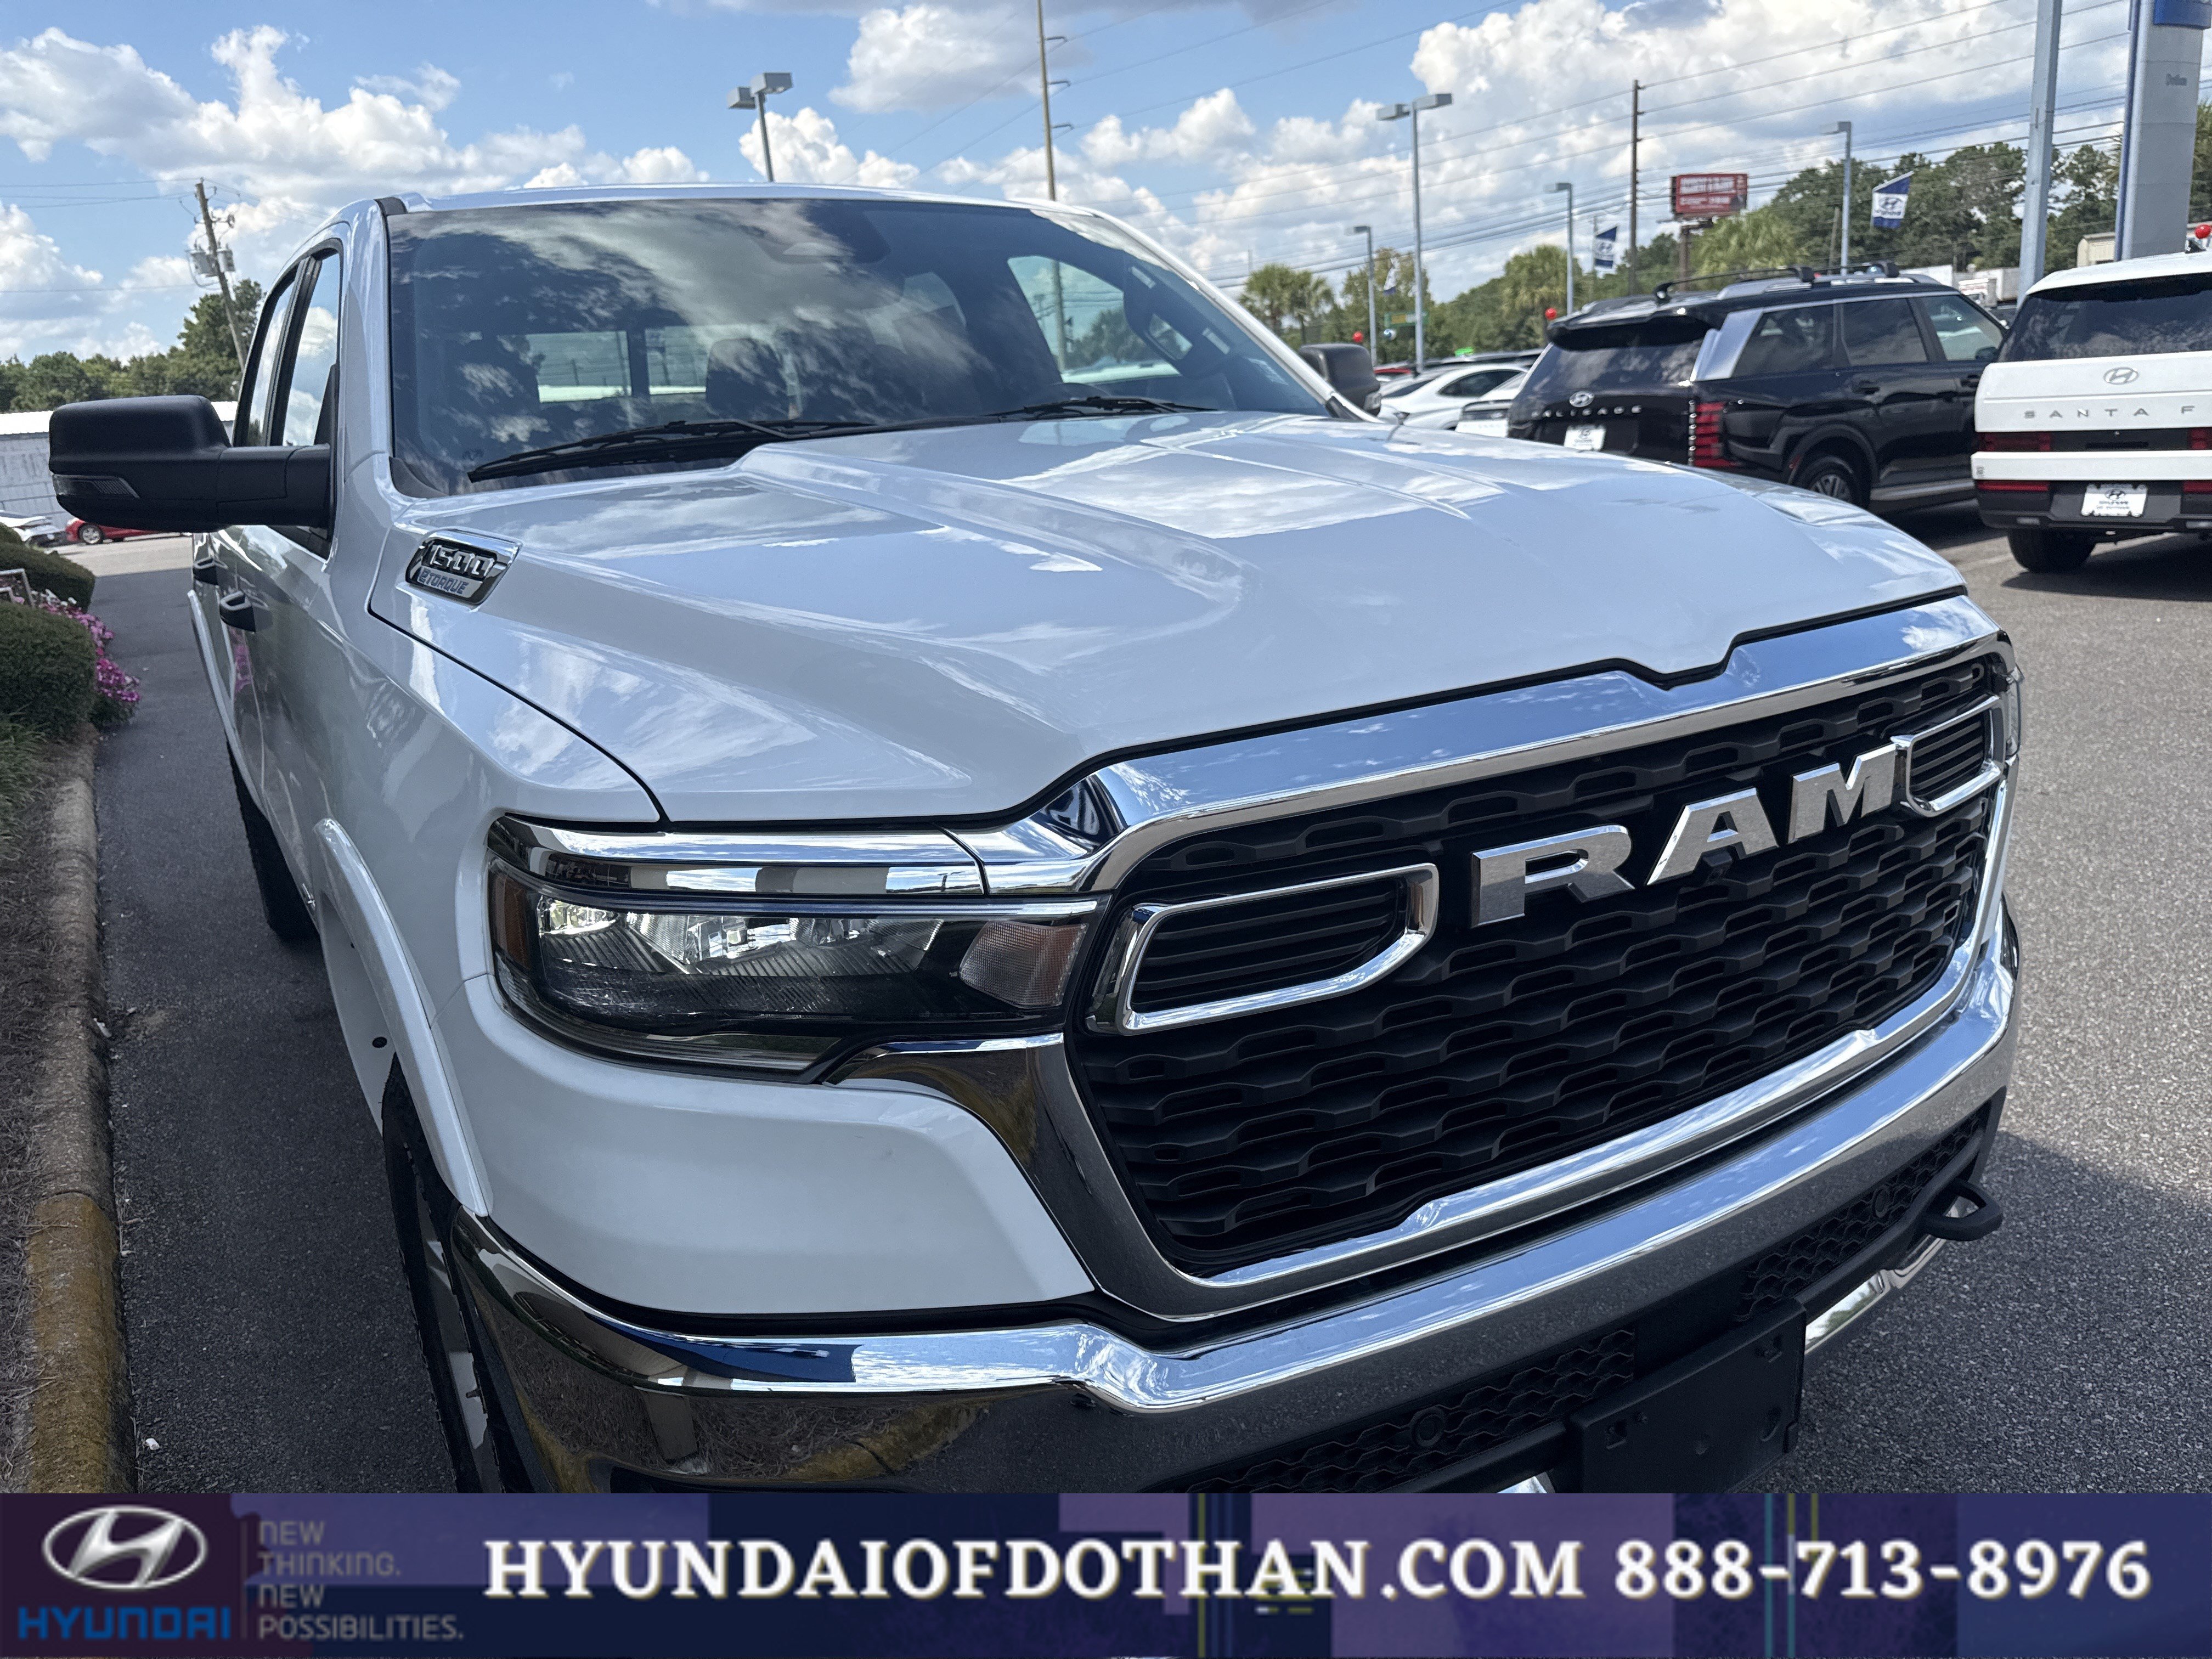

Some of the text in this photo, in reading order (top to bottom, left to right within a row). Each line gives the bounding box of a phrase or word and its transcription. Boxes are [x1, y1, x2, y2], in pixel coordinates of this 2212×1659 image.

[2023, 406, 2150, 419] SANTA
[430, 544, 495, 577] 1500
[1471, 742, 1897, 928] RAM
